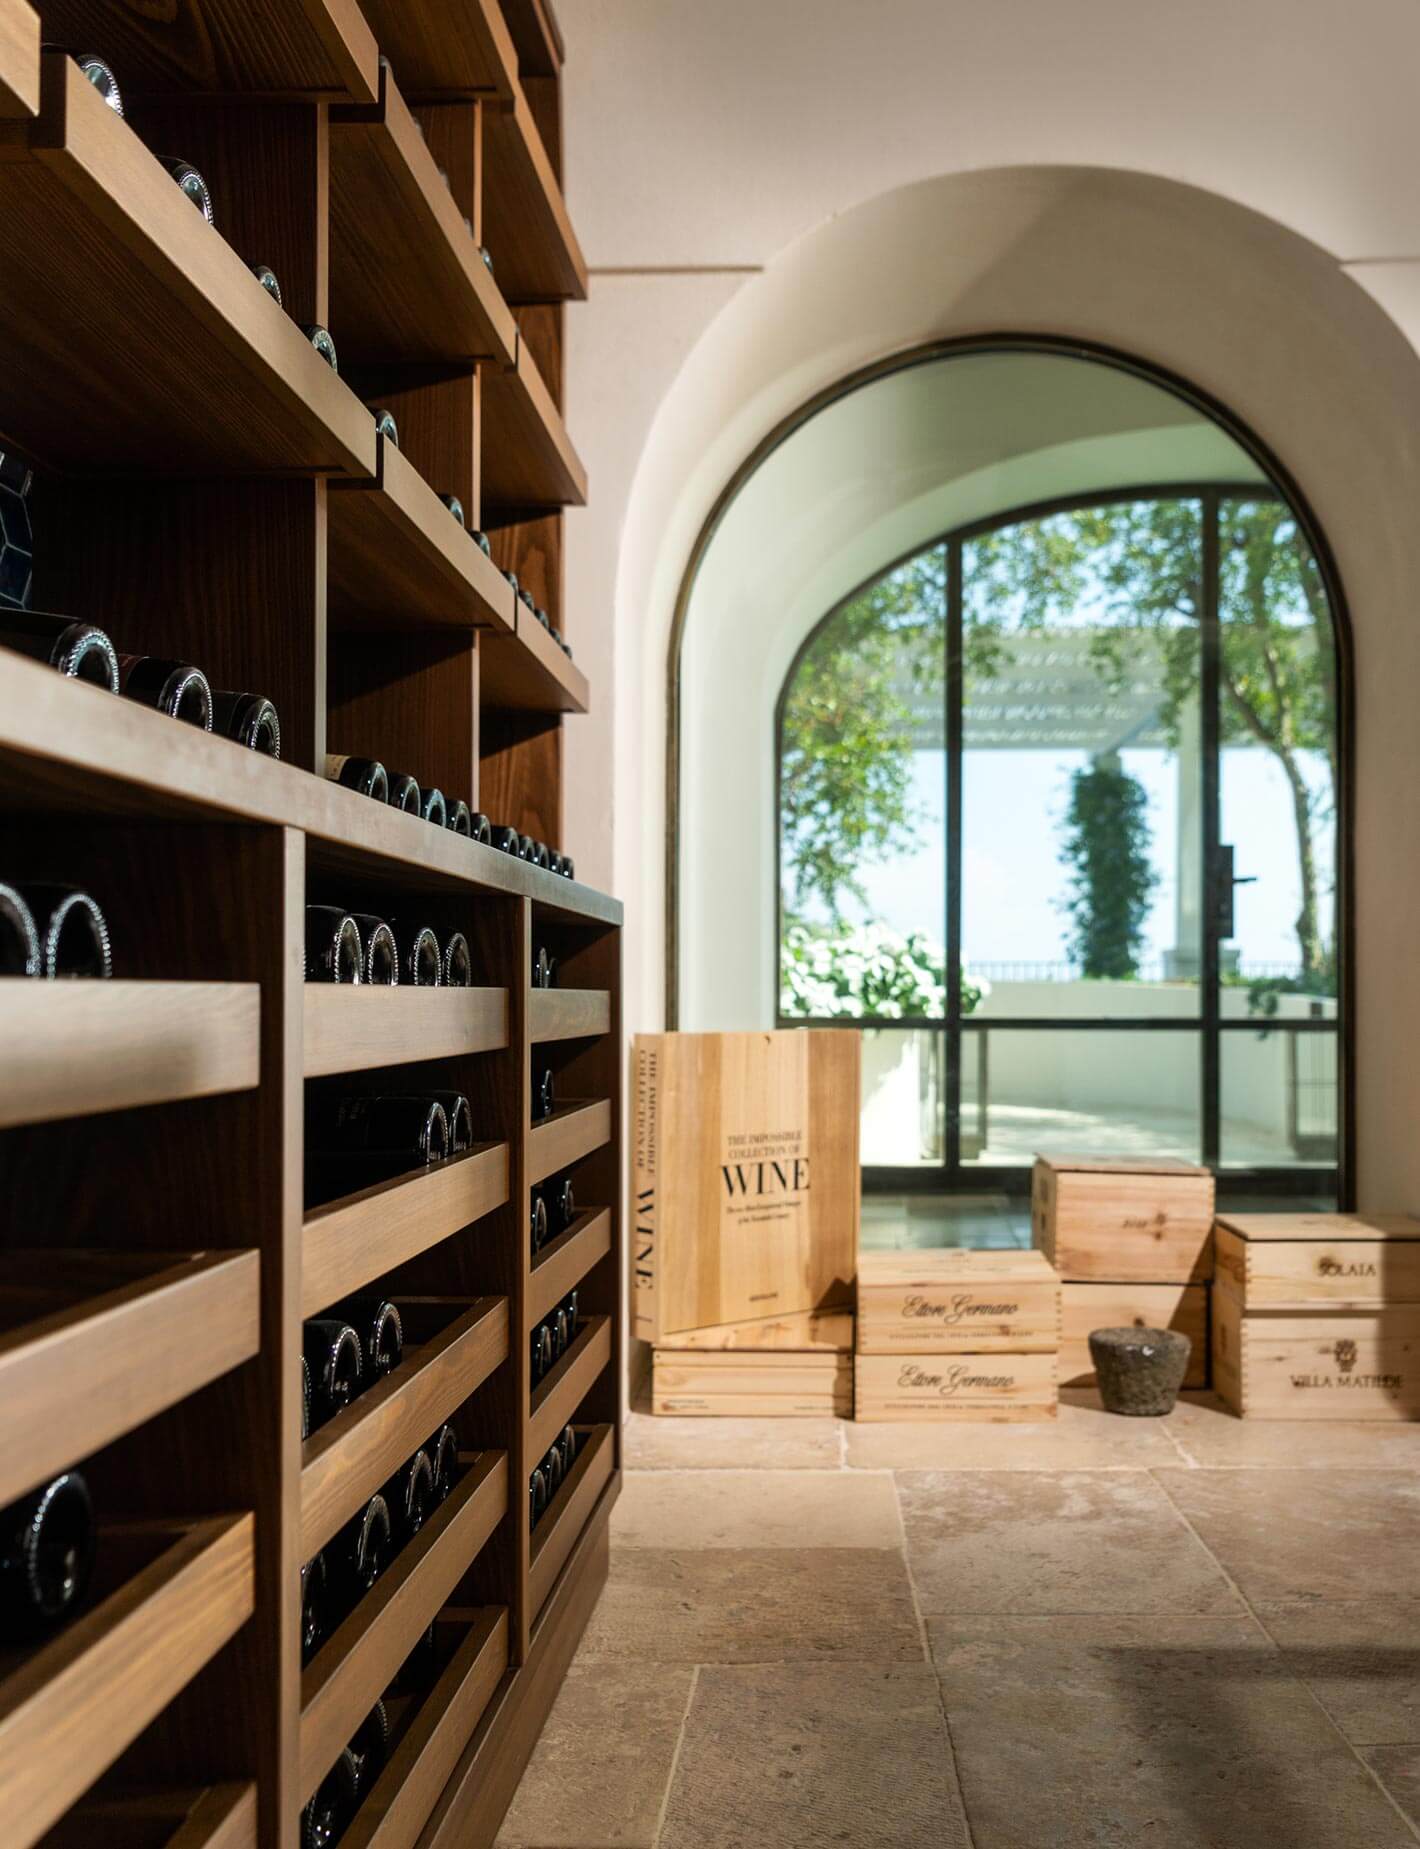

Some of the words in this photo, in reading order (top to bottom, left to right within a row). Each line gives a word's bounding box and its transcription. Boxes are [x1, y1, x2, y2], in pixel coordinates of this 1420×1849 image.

[648, 1051, 657, 1081] THE
[727, 1134, 747, 1146] THE
[749, 1129, 802, 1145] IMPOSSIBLE
[728, 1146, 786, 1159] COLLECTION
[719, 1158, 810, 1197] WINE
[635, 1187, 655, 1290] WINE
